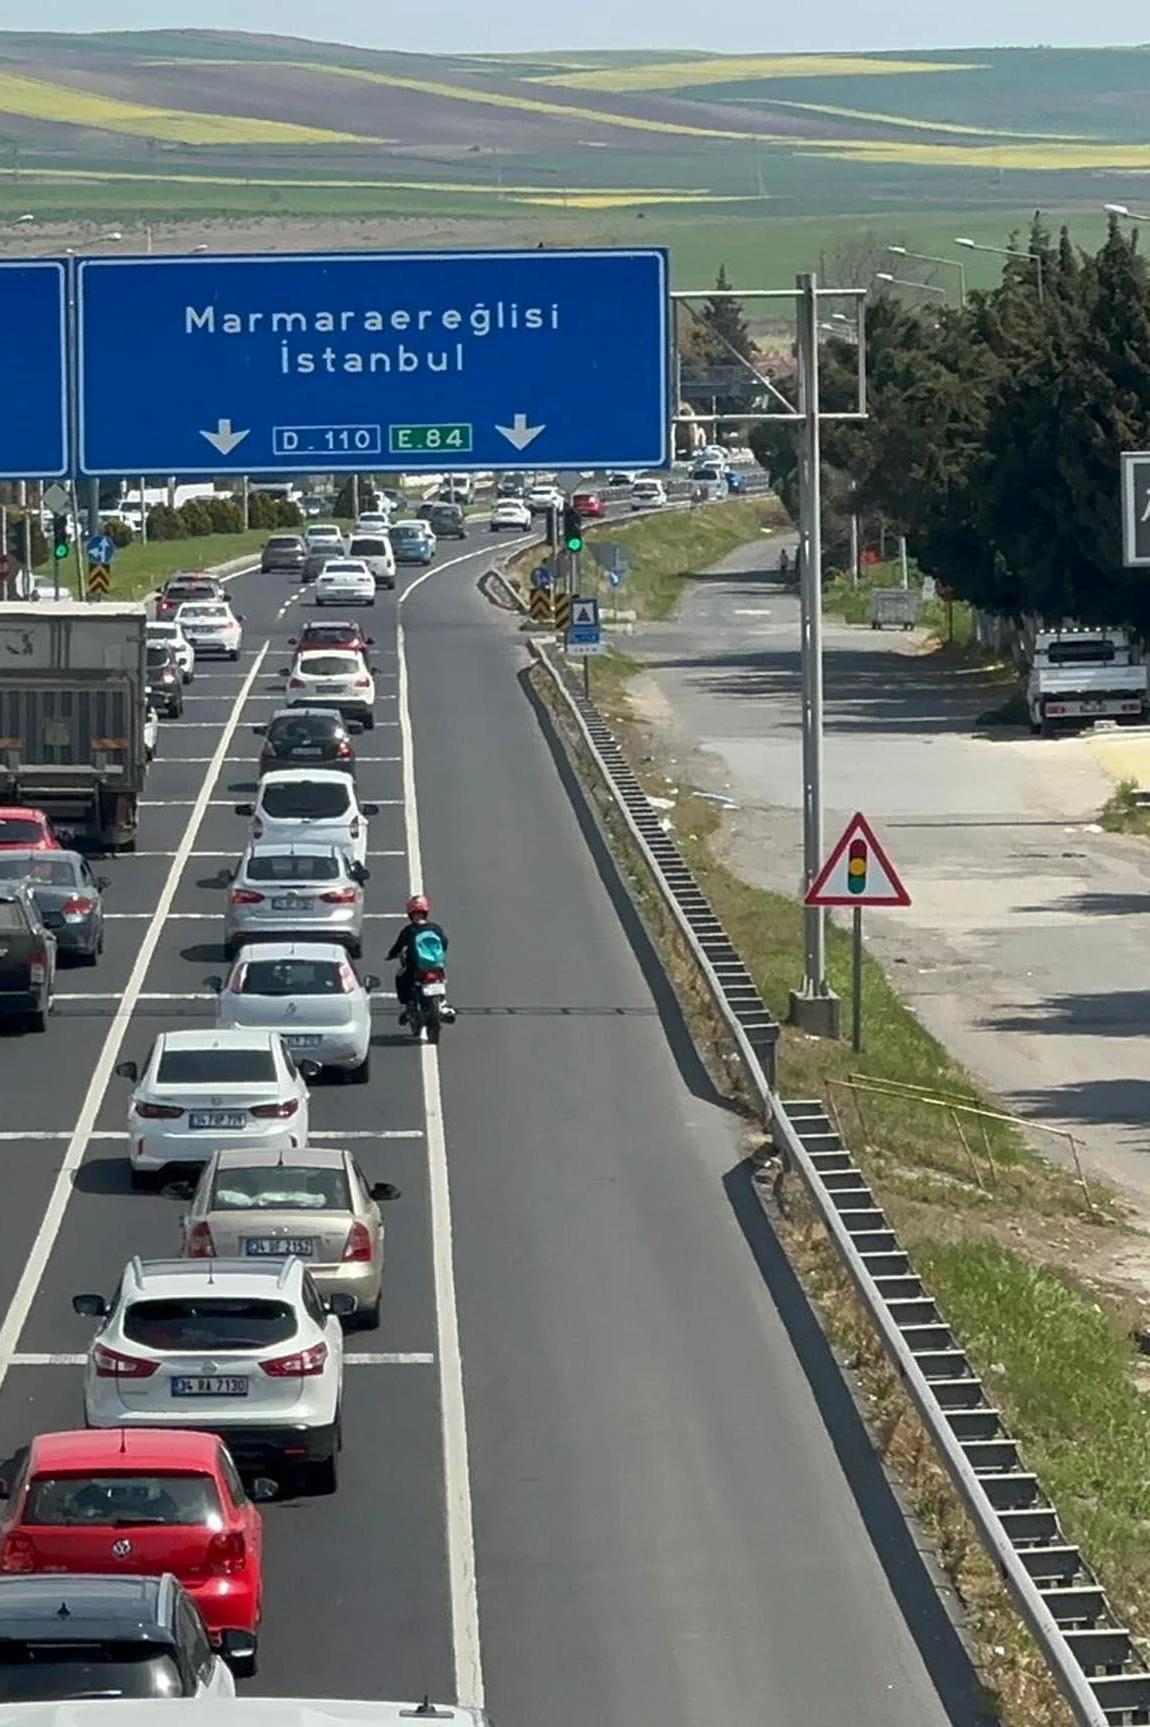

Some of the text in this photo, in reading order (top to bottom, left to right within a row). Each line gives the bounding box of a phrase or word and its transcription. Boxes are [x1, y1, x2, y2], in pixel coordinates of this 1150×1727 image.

[185, 303, 559, 336] Marmaraereğlisi
[281, 340, 463, 373] İstanbul
[217, 1379, 245, 1392] 7130
